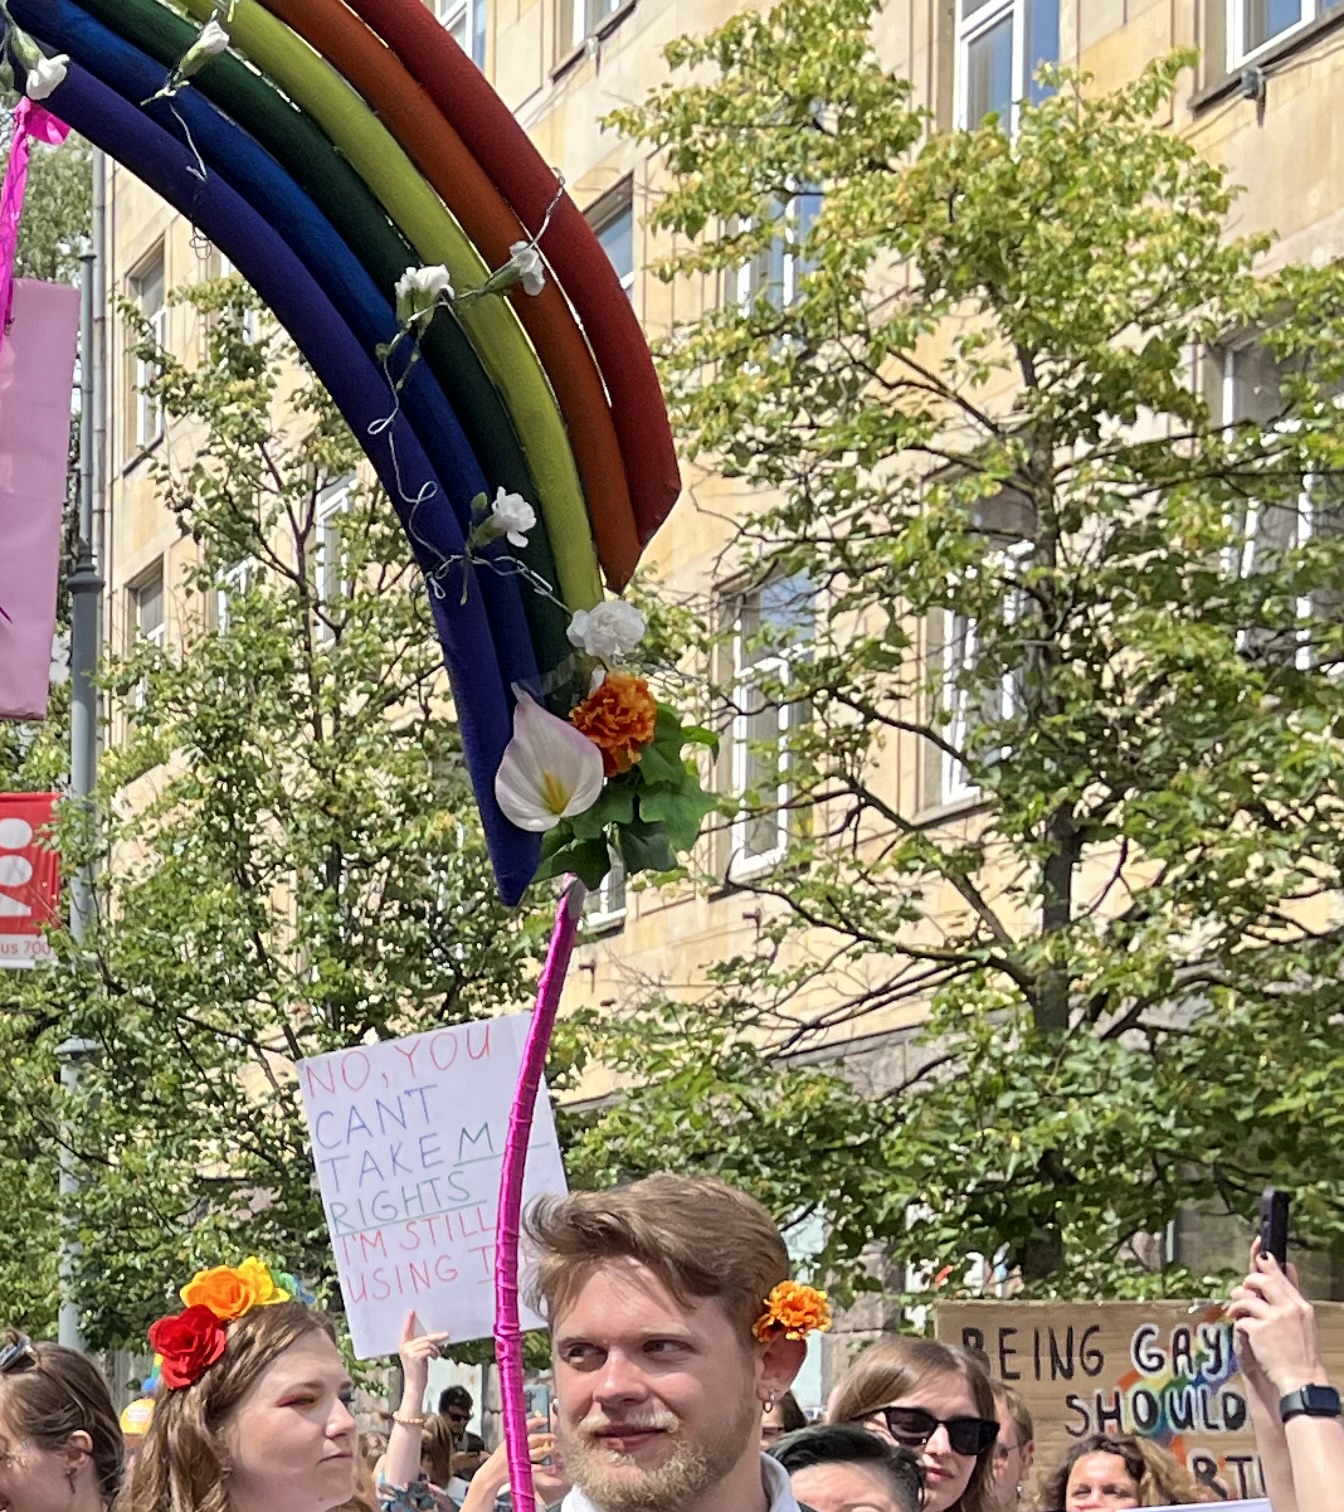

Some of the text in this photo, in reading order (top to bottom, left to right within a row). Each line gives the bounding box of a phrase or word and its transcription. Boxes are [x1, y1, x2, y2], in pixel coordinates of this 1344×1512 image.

[23, 940, 51, 955] 700
[305, 1023, 492, 1099] NO, YOU
[315, 1084, 439, 1150] CAN'T
[320, 1132, 444, 1194] TAKE
[329, 1170, 471, 1235] RIGHTS
[341, 1205, 496, 1266] I'M STILL
[345, 1254, 459, 1304] USING
[1131, 1325, 1224, 1379] GAY
[1064, 1388, 1249, 1437] SHOULD
